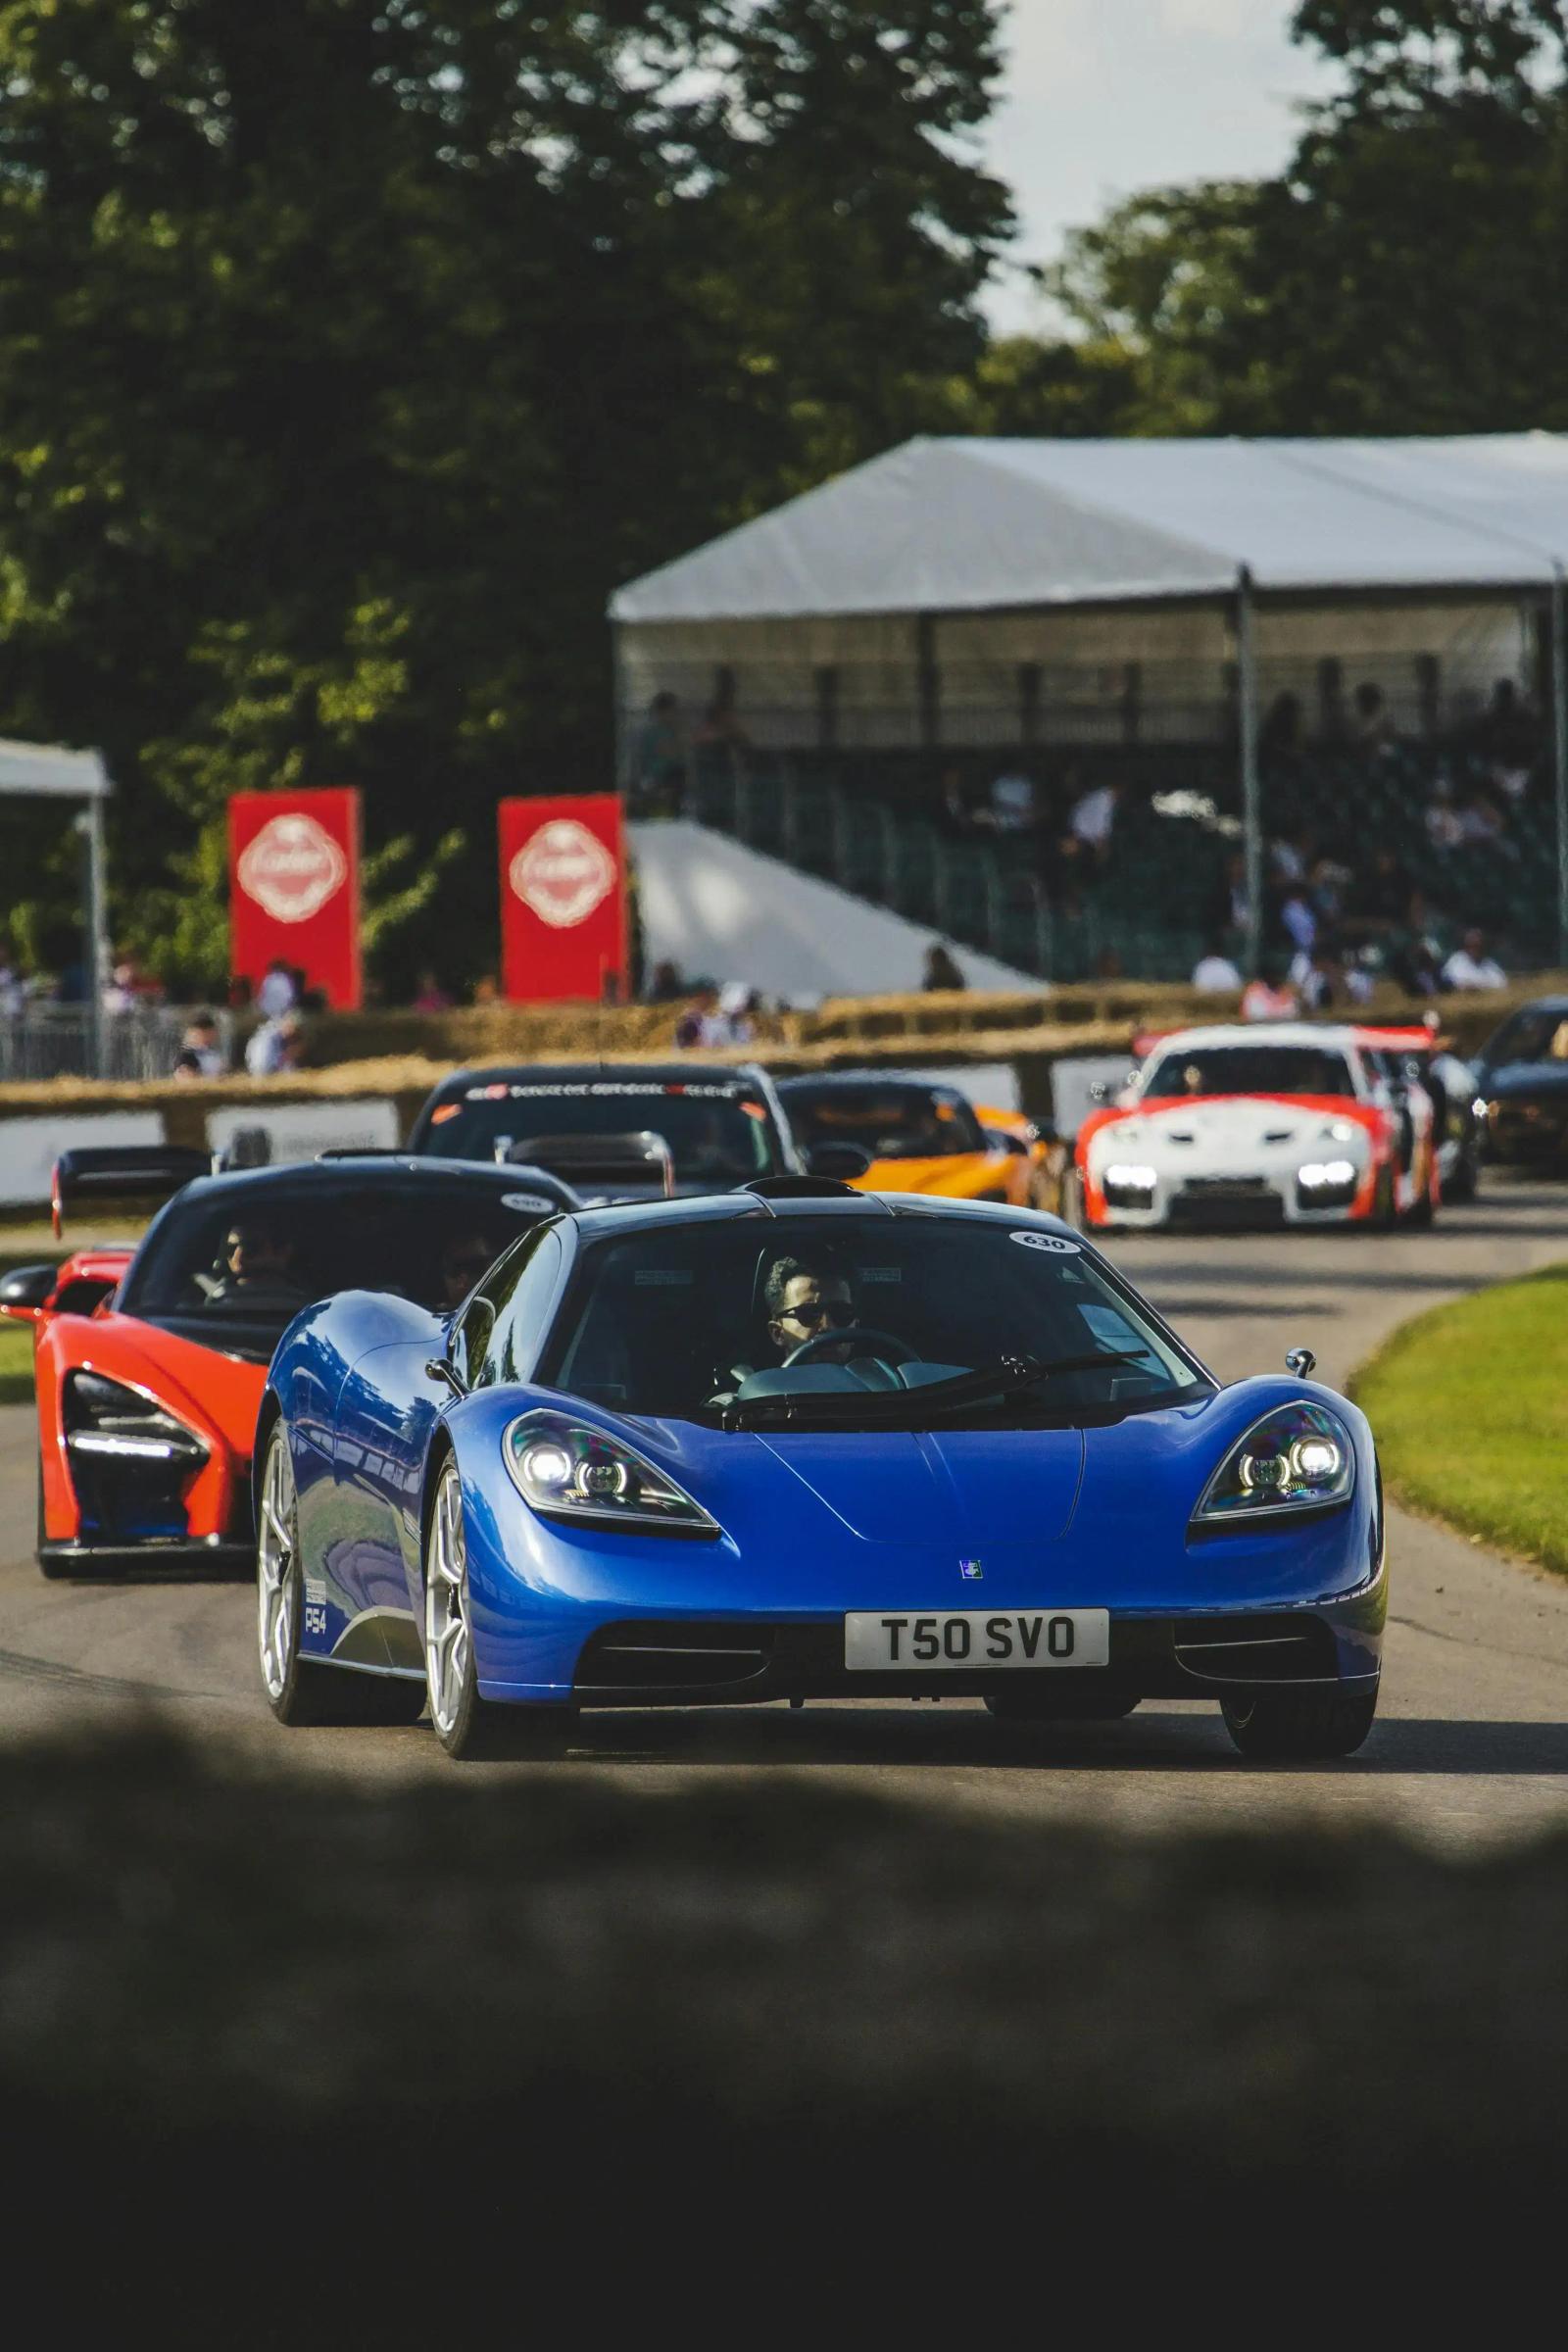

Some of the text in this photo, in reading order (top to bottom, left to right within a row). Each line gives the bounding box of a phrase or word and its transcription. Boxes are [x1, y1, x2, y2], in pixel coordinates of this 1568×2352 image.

[1023, 1236, 1065, 1250] 630
[881, 1616, 1075, 1660] T50 SVO
